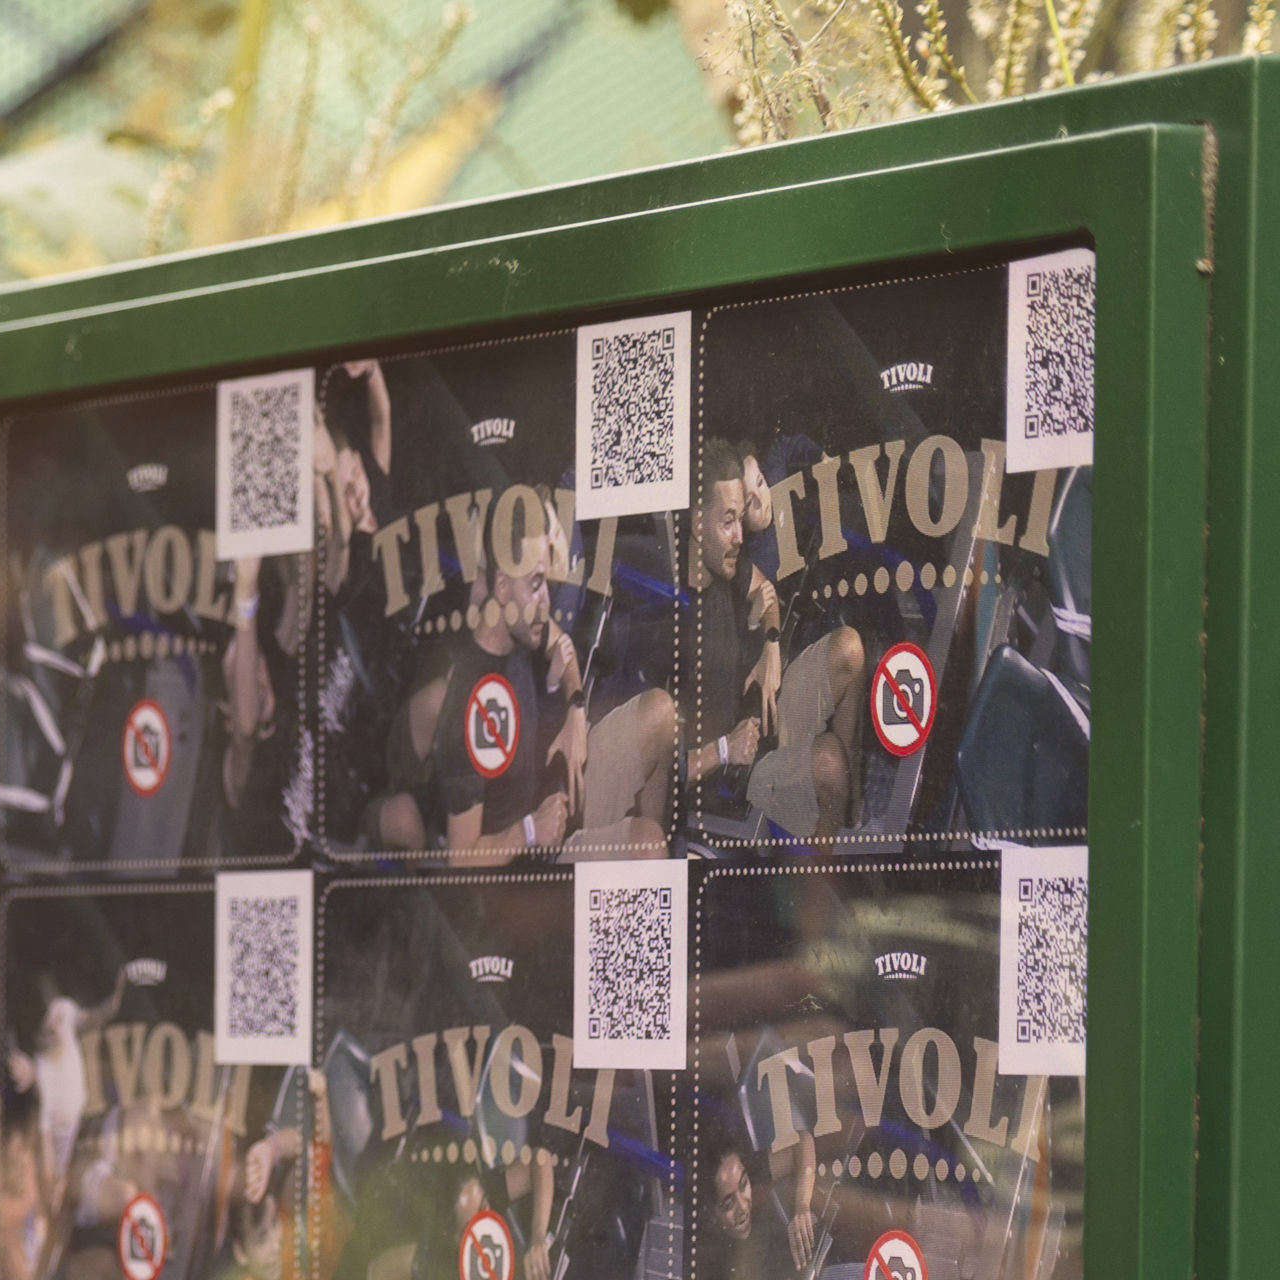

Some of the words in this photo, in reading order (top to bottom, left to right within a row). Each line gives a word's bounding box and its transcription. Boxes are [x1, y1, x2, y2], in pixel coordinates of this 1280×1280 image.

[880, 362, 934, 390] TIVOLI
[471, 417, 516, 443] TIVOLI
[769, 434, 1054, 581] TIVOLI
[372, 484, 617, 617] TIVOLI
[468, 955, 514, 979] TIVOLI
[875, 951, 928, 977] TIVOLI
[369, 1024, 616, 1149] TIVOLI
[757, 1027, 1047, 1164] TIVOLI
